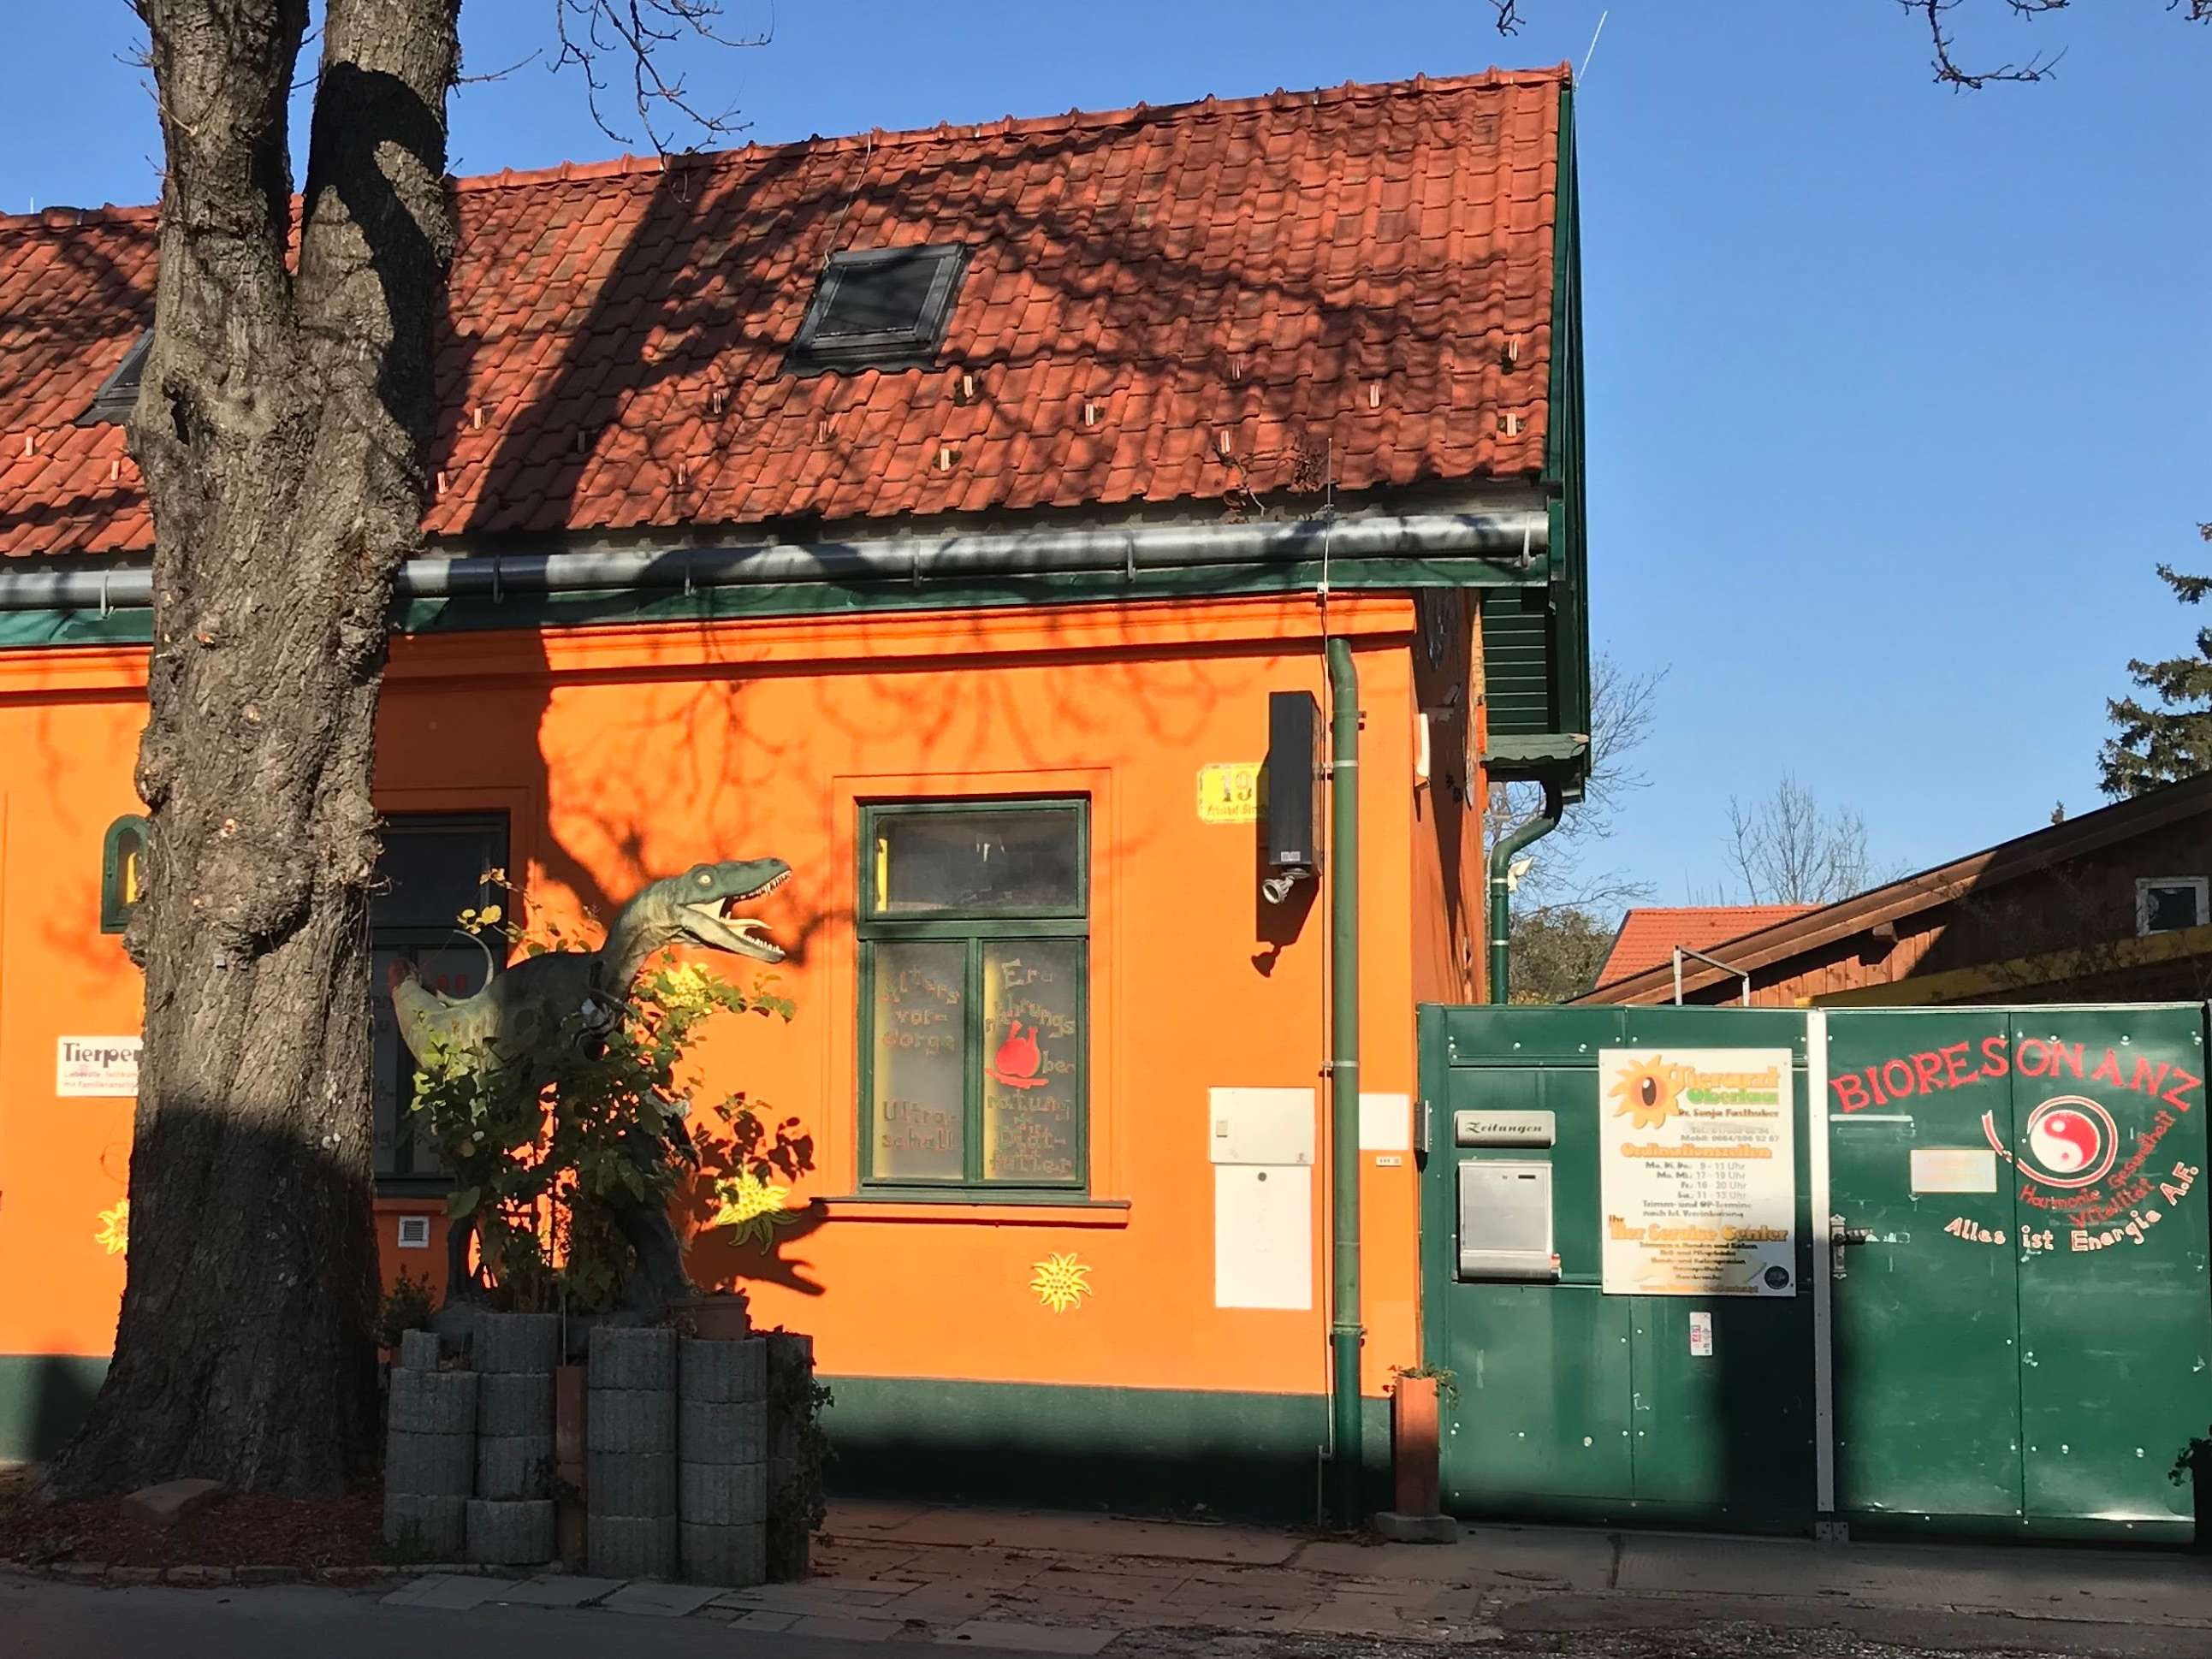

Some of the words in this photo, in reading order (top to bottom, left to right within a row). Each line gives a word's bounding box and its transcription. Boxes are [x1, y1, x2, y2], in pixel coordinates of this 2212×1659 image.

[1219, 770, 1252, 802] 19
[1829, 1035, 2203, 1113] BIORESONANZ
[1693, 1108, 1723, 1119] Sonja
[1464, 1121, 1544, 1135] Zeitungen
[1729, 1181, 1747, 1189] Uhr
[1678, 1200, 1698, 1208] und
[2018, 1183, 2102, 1209] Harmonie
[1647, 1224, 1717, 1241] Service
[1720, 1224, 1788, 1242] Center
[1943, 1216, 2007, 1246] Alles
[2020, 1224, 2055, 1251] ist
[2071, 1209, 2162, 1252] Energie
